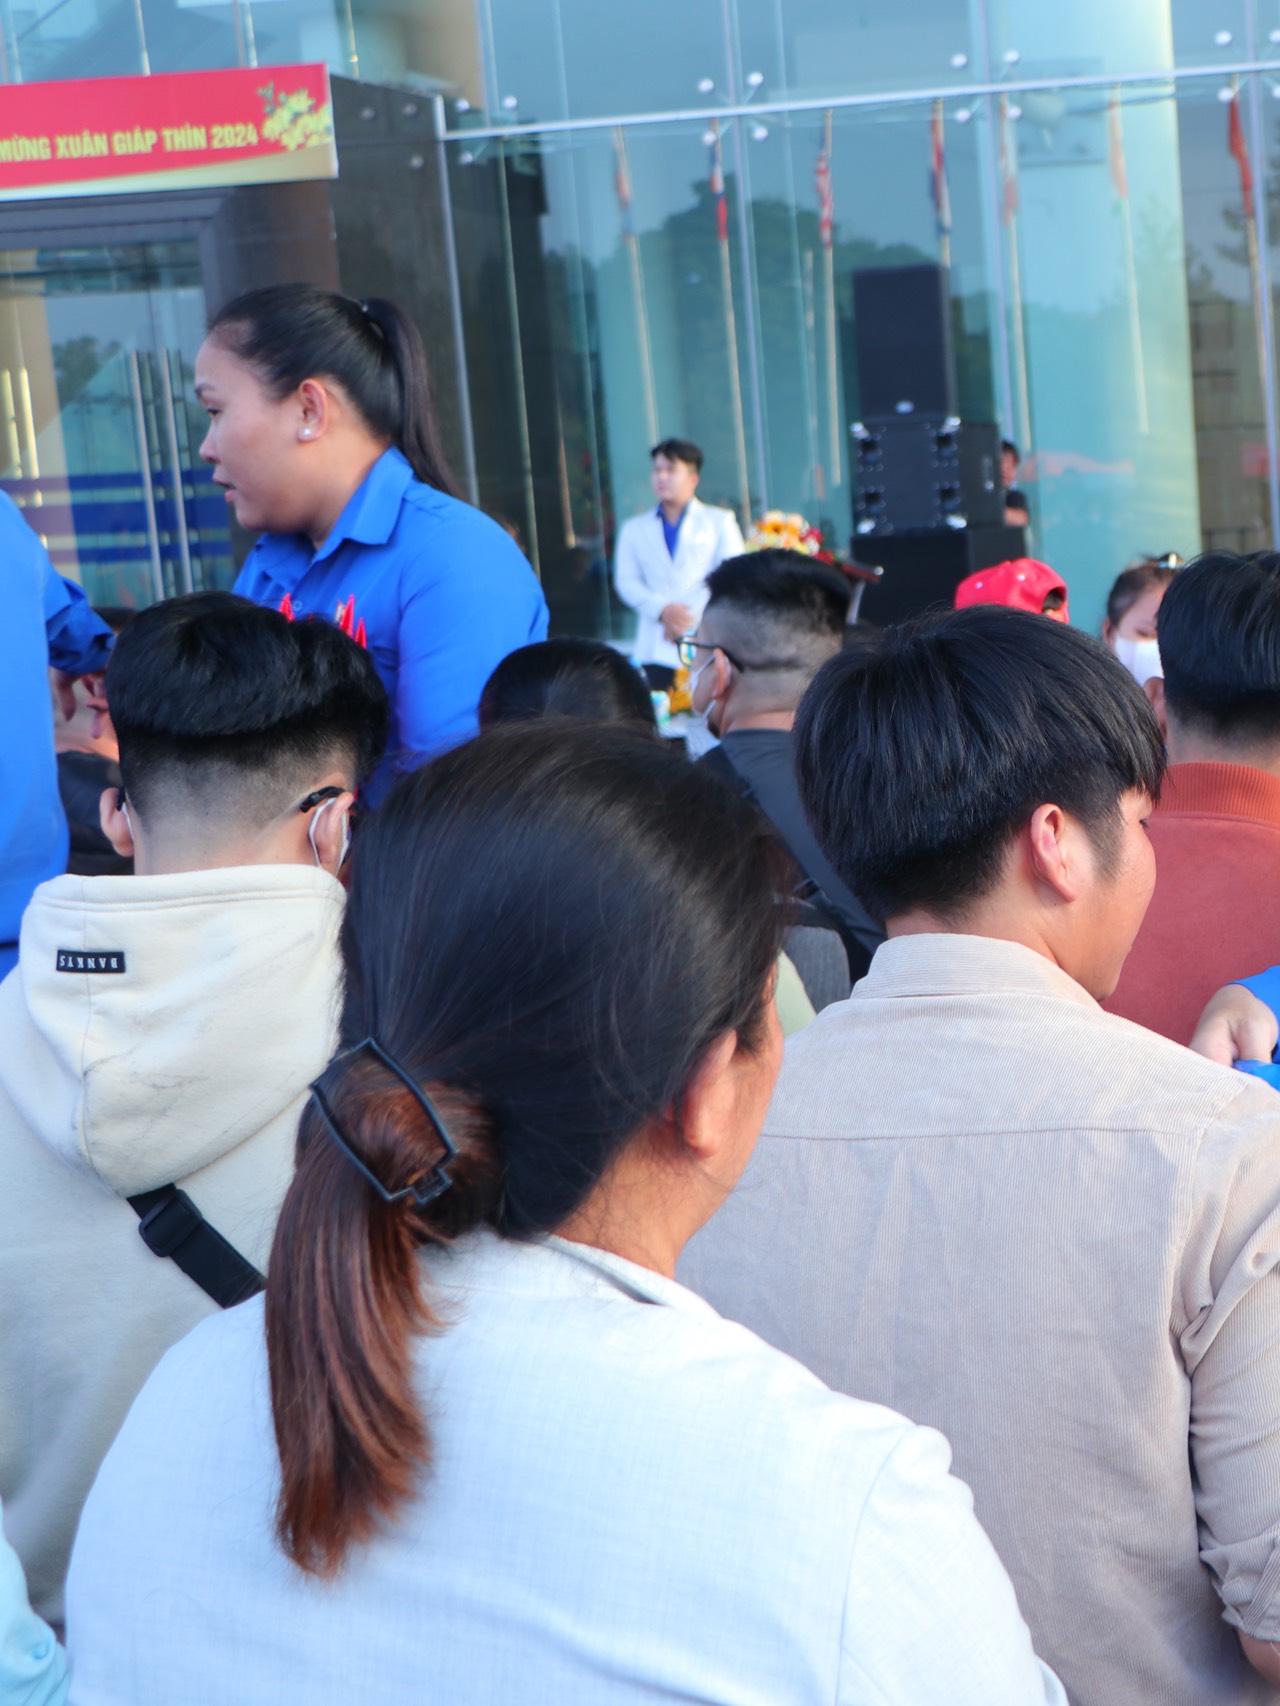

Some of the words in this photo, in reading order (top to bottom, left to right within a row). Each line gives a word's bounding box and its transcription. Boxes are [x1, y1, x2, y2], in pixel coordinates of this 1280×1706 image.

[55, 129, 108, 159] XUÂN
[113, 125, 158, 155] GIÁP
[162, 122, 207, 152] THÌN
[212, 123, 258, 149] 2024
[59, 955, 118, 969] BANKYS
